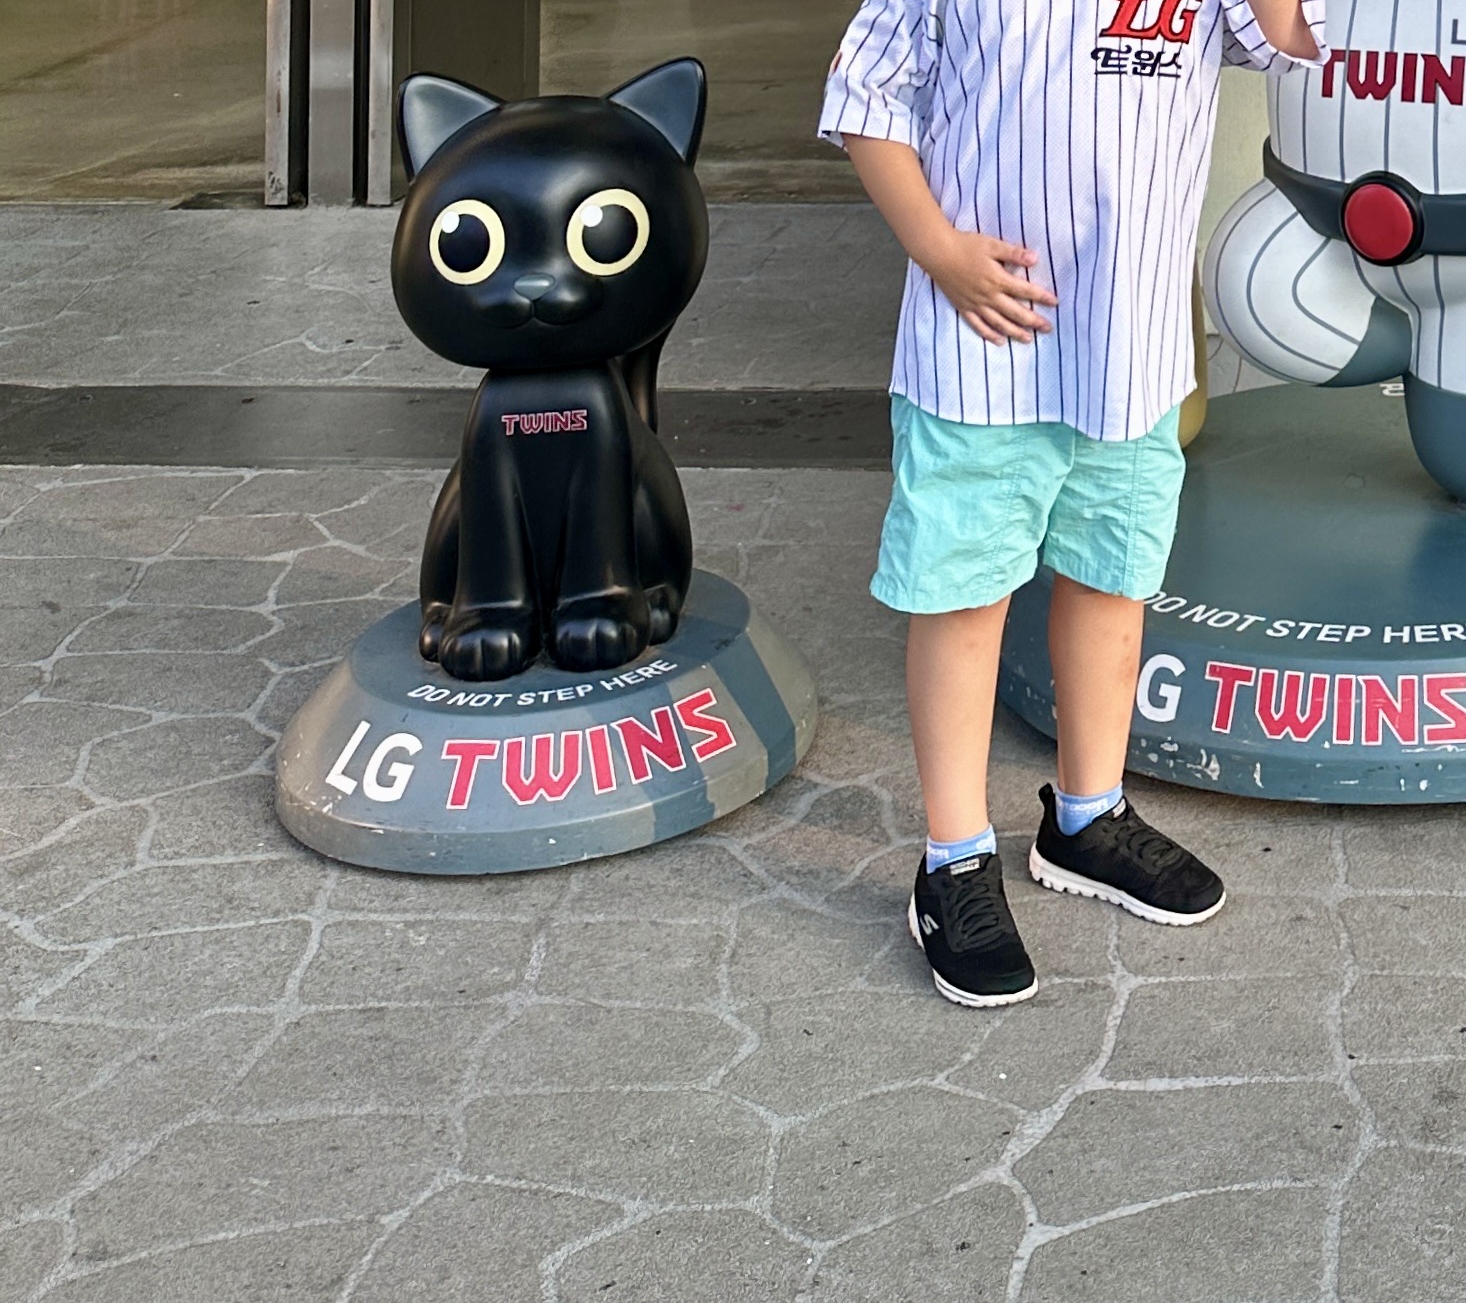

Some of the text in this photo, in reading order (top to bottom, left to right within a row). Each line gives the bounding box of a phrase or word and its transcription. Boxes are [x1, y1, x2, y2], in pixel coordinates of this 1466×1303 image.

[1090, 46, 1183, 79] 트윈스
[501, 408, 588, 435] TWINS
[1182, 603, 1267, 632] NOT
[1265, 619, 1371, 644] STEP
[407, 658, 678, 709] DO NOT STEP HERE
[1136, 653, 1186, 723] G
[325, 688, 738, 811] LG TWINS
